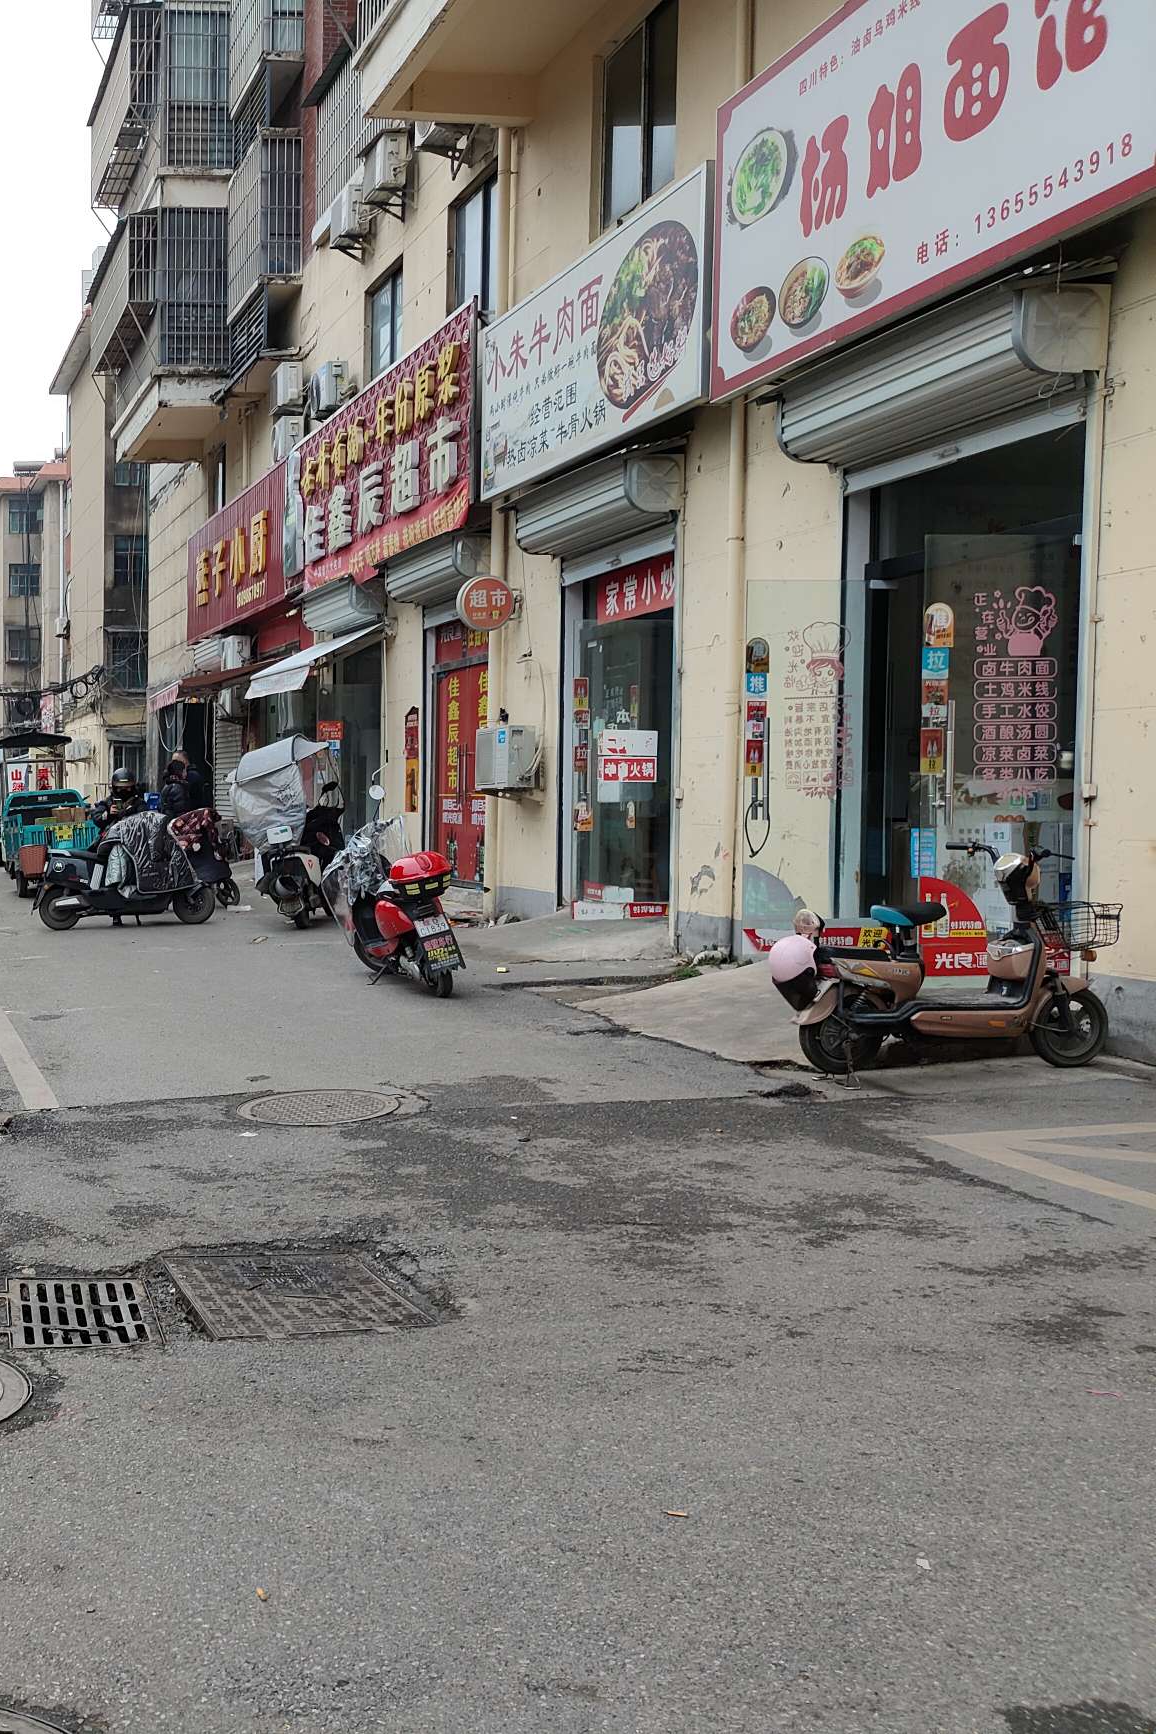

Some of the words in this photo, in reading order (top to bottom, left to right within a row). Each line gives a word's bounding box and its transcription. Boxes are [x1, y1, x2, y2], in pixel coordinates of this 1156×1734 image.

[486, 274, 604, 393] 小朱牛肉面
[528, 381, 578, 428] 经营范围
[605, 561, 675, 616] 家常小炒
[469, 588, 508, 608] 超市
[982, 661, 1049, 676] 卤牛肉面
[983, 682, 1049, 698] 土鸡米线
[478, 671, 489, 729] 佳鑫
[982, 704, 1050, 719] 手工水饺
[447, 676, 460, 790] 佳鑫辰超市
[982, 725, 1049, 740] 酒酿汤圆
[982, 746, 1049, 761] 凉菜卤菜
[863, 929, 883, 938] 欢迎
